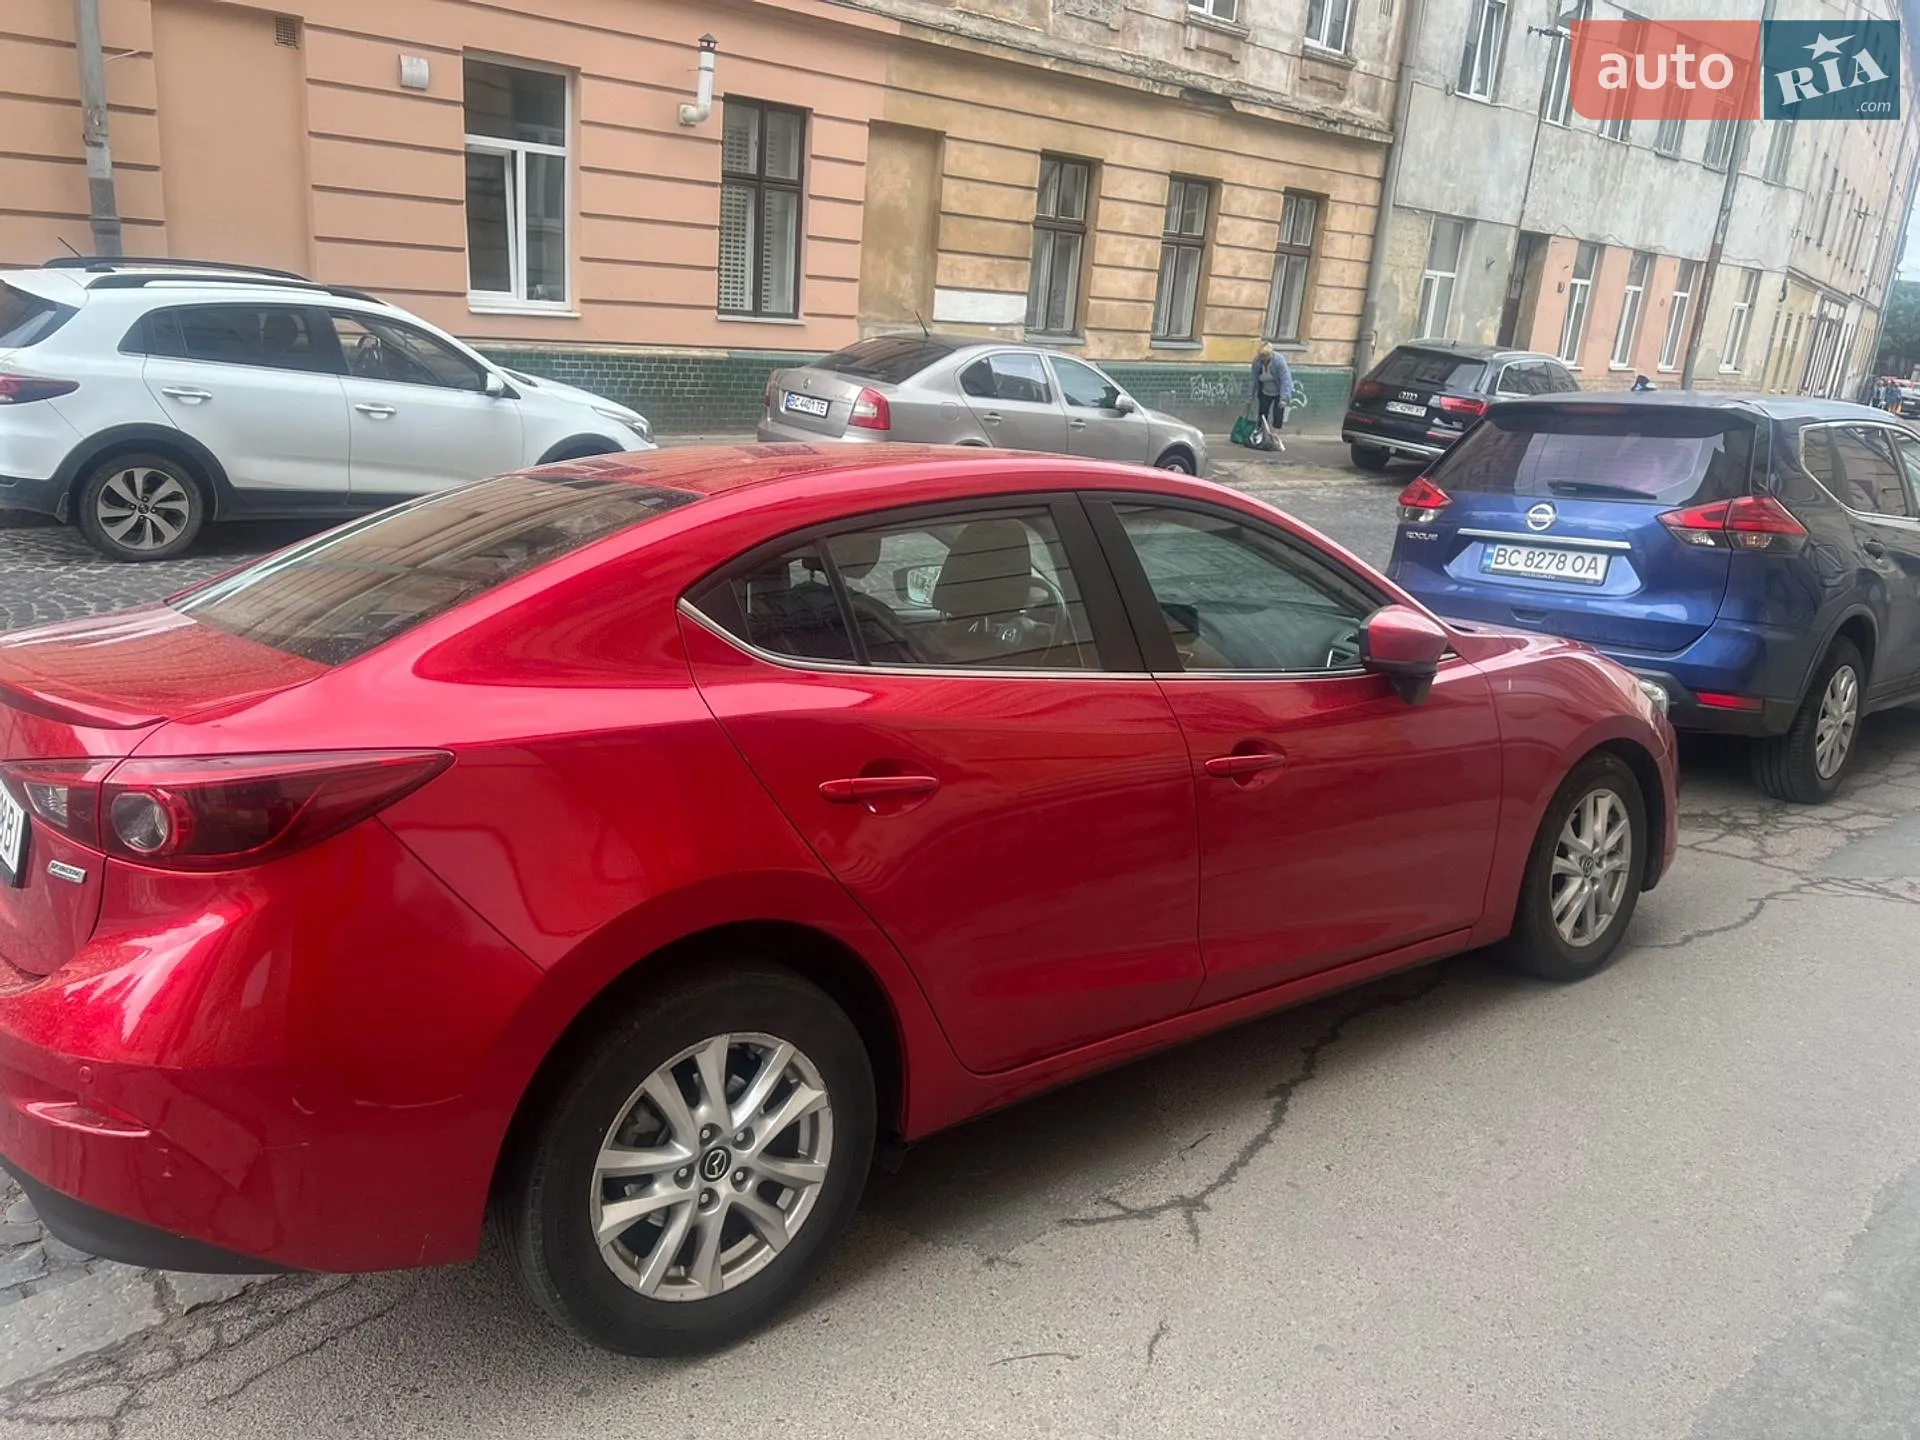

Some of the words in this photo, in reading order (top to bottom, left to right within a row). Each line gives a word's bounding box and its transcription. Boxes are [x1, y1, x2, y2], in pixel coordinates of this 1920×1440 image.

[1494, 547, 1521, 567] BC
[1524, 551, 1568, 571] 8278
[1571, 555, 1598, 575] OA
